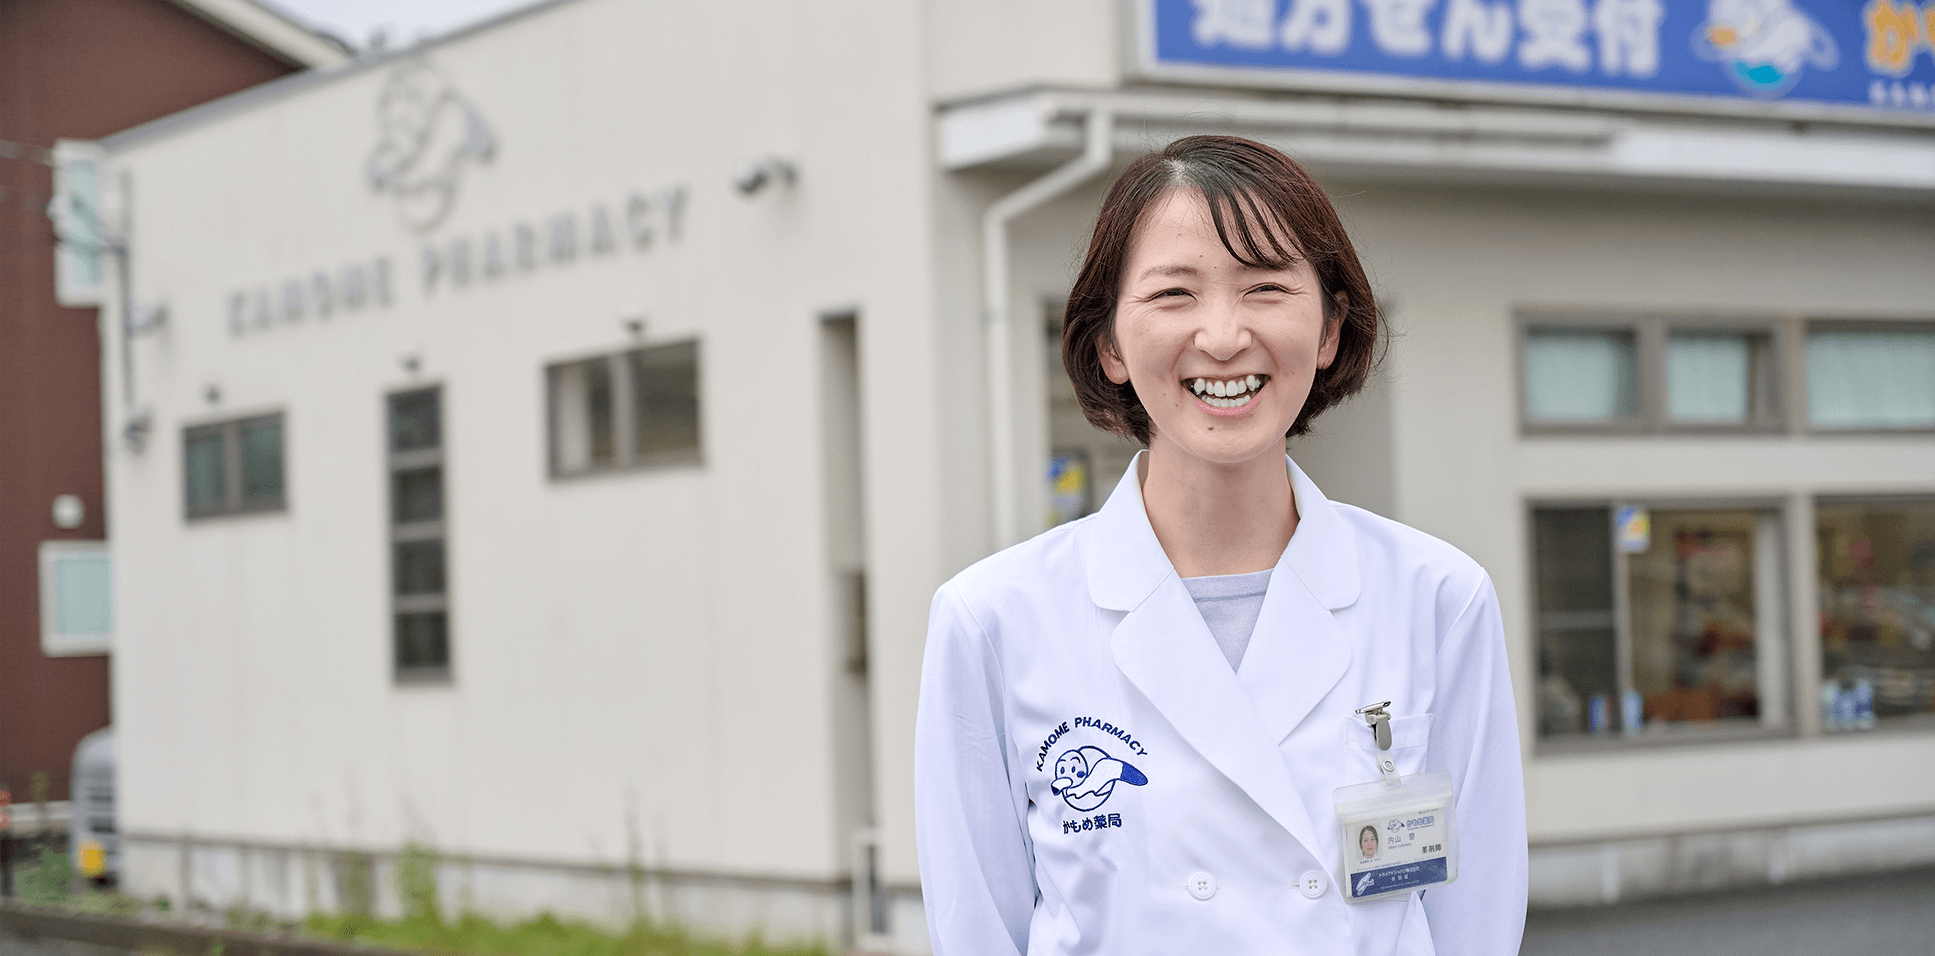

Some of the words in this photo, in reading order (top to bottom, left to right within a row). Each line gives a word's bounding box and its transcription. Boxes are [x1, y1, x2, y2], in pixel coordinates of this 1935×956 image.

[228, 256, 392, 337] KAMOME
[421, 186, 689, 297] PHARMACY
[1036, 721, 1070, 772] KAMOME
[1074, 716, 1148, 757] PHARMACY
[1063, 813, 1122, 835] かもめ薬局
